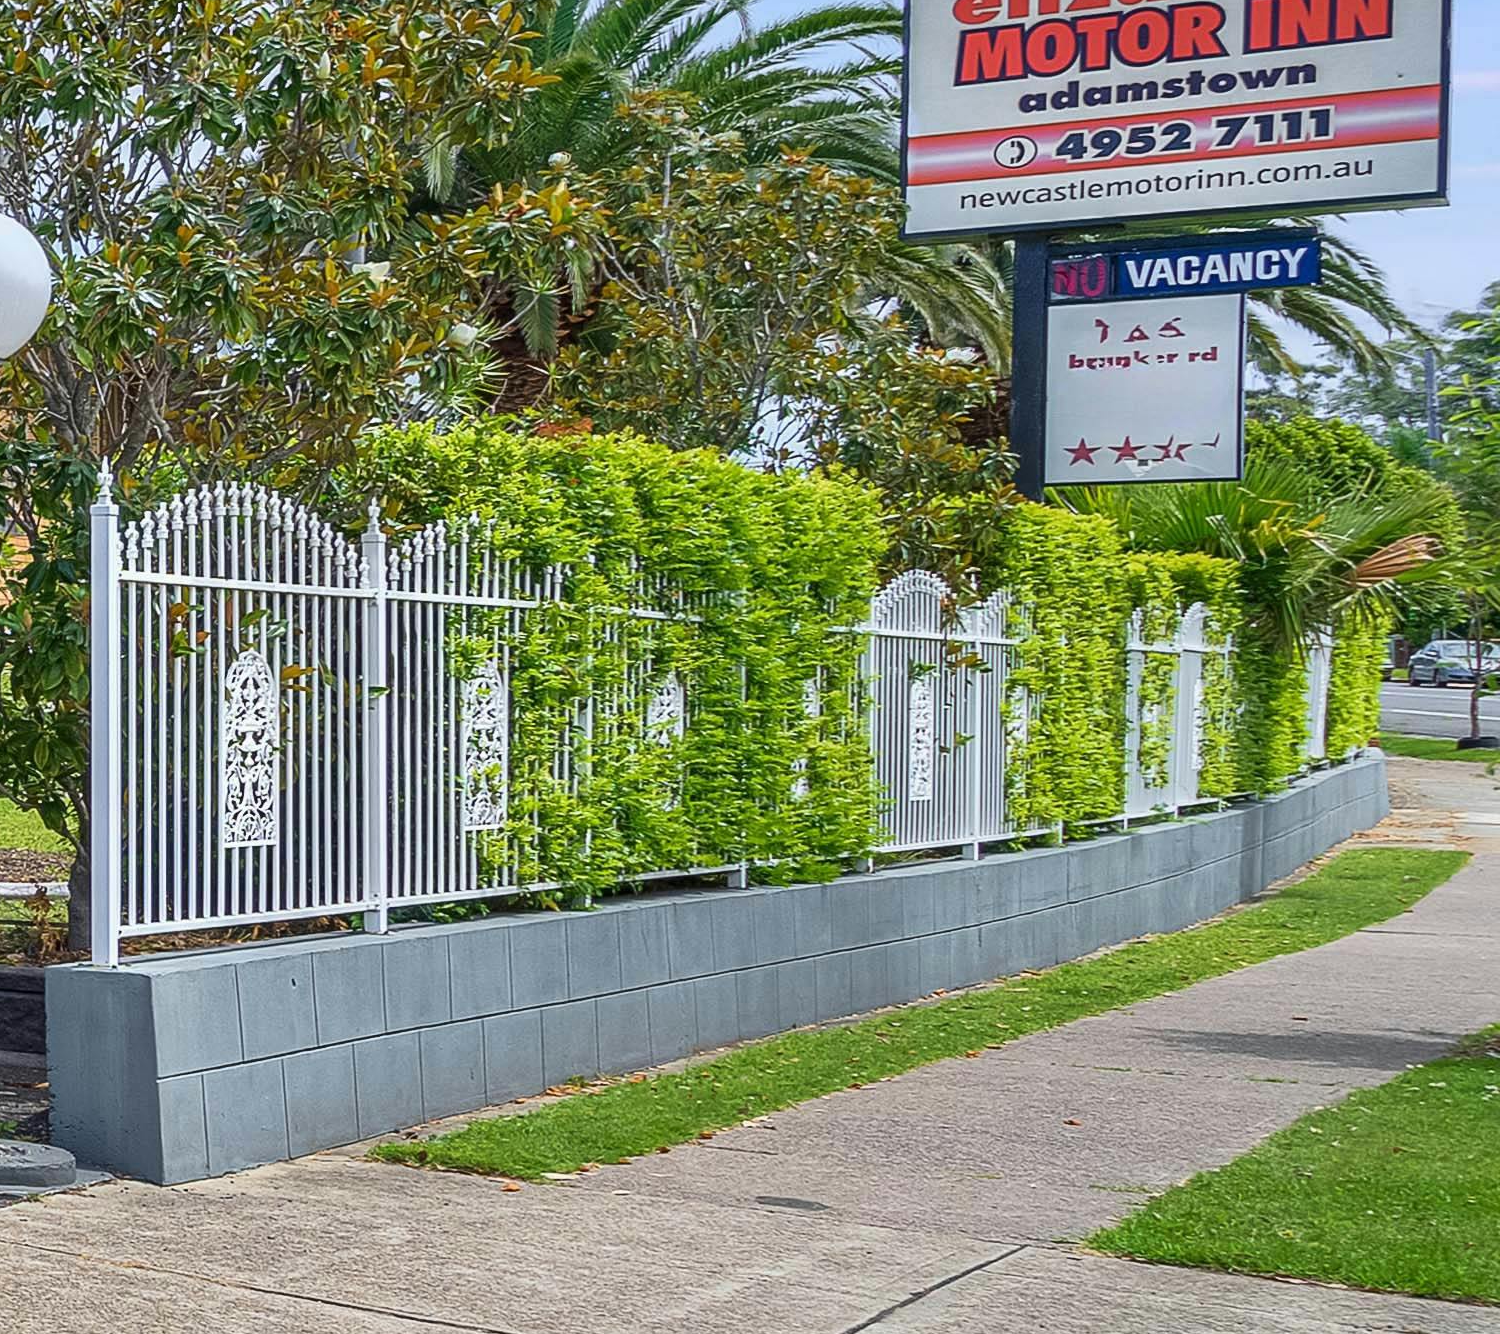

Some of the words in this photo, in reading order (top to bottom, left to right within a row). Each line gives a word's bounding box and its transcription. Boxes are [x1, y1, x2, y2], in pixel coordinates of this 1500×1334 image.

[954, 1, 1230, 87] MOTOR
[1018, 63, 1318, 114] adamstown
[1054, 120, 1193, 161] 4952
[1213, 107, 1332, 147] 7111
[959, 158, 1375, 210] newcastlemotorinn.com.au
[1124, 247, 1308, 289] VACANCY
[1188, 346, 1219, 363] rd
